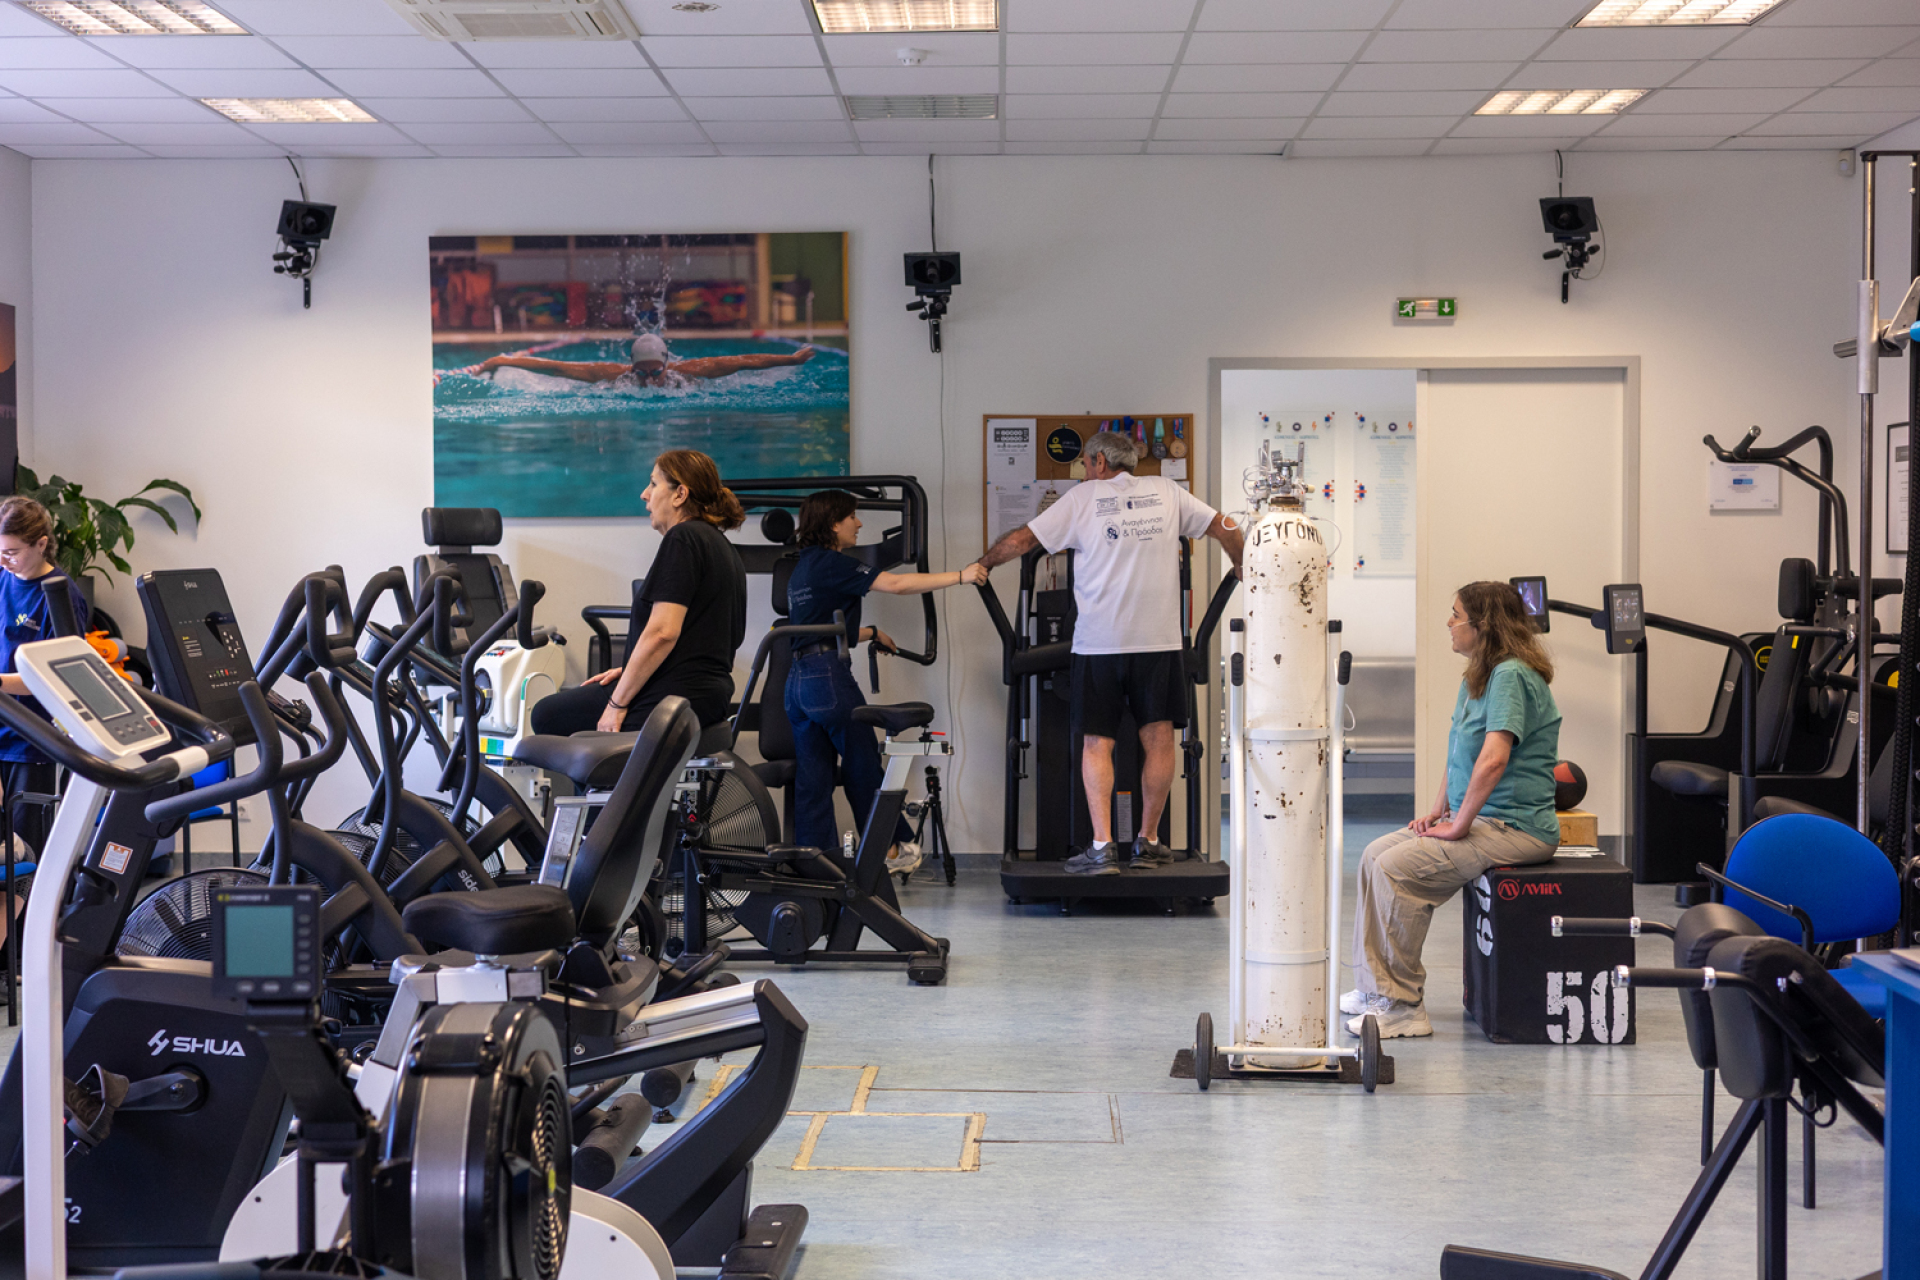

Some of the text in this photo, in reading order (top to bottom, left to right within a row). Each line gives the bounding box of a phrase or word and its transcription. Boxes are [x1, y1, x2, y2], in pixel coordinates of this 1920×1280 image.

[1121, 516, 1163, 527] Αναγέννηση
[1122, 525, 1163, 538] & Πρόοδος
[1546, 970, 1629, 1044] 50
[172, 1036, 246, 1057] SHUA
